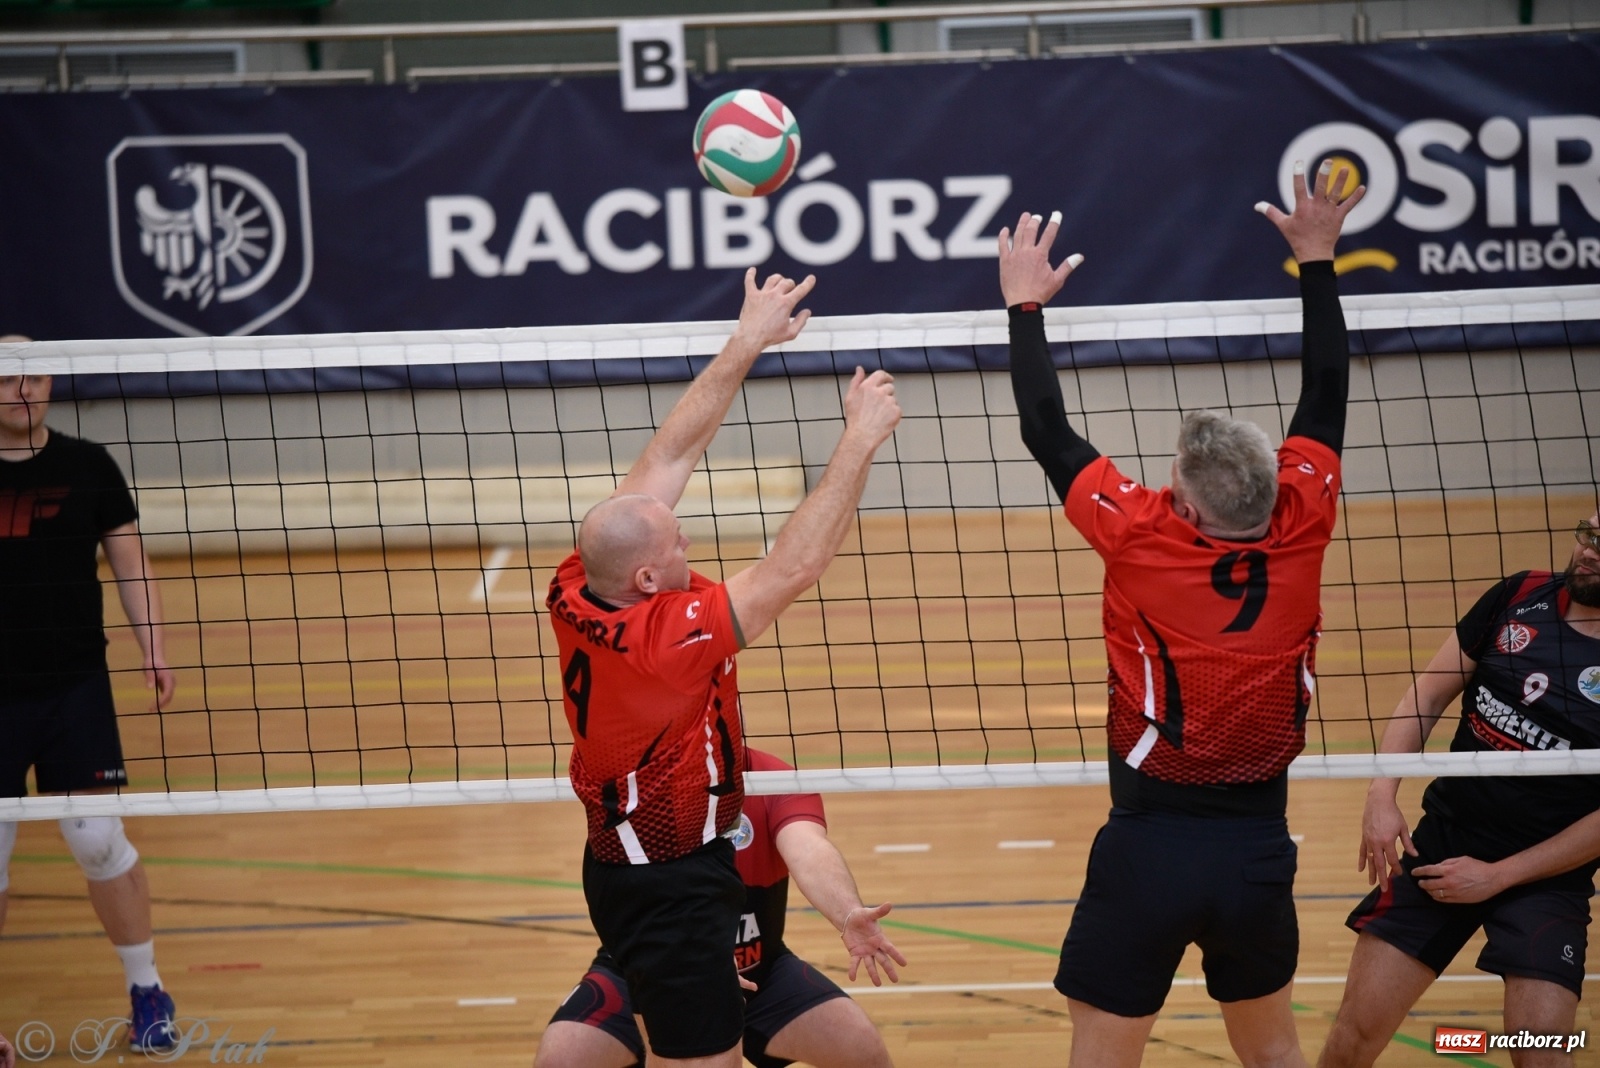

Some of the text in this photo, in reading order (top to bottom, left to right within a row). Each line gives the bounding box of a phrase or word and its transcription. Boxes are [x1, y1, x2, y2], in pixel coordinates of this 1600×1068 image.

[632, 40, 676, 89] B
[426, 152, 1012, 279] RACIBÓRZ
[1278, 114, 1600, 236] OSiR
[1210, 549, 1269, 633] 9
[564, 647, 591, 739] 4
[1521, 672, 1549, 706] 9
